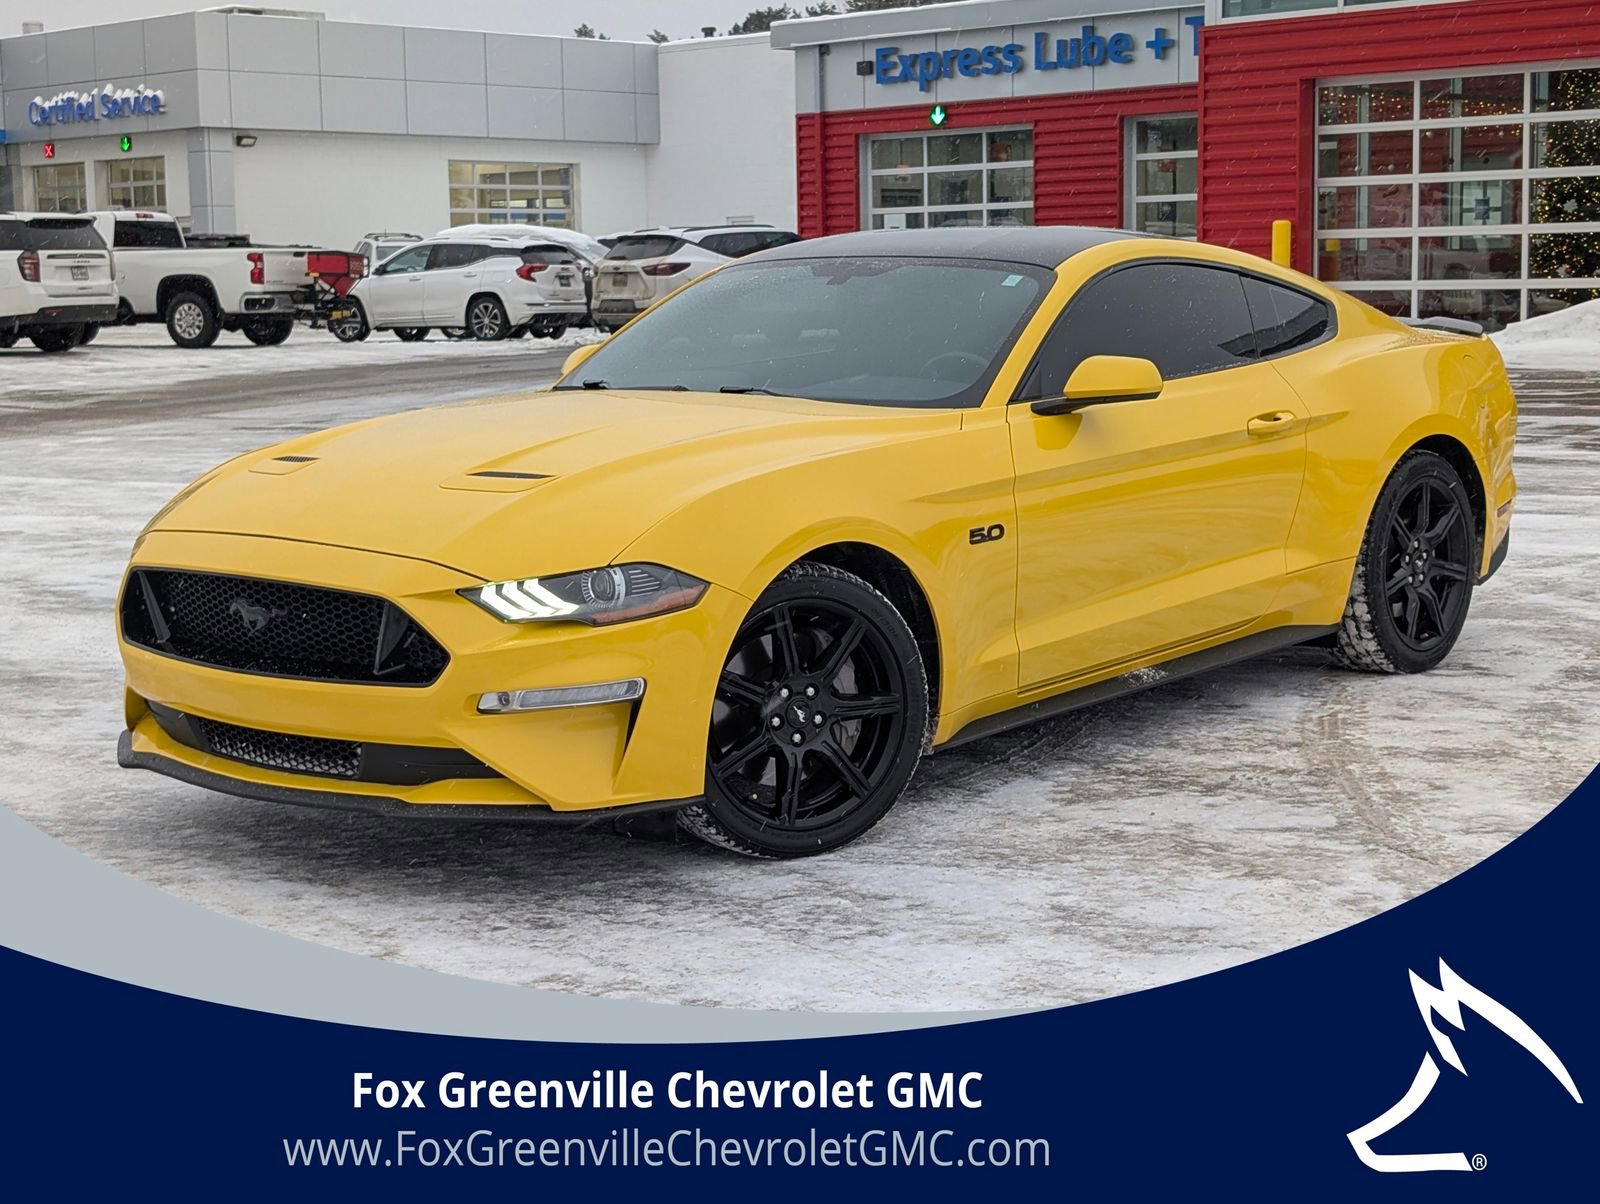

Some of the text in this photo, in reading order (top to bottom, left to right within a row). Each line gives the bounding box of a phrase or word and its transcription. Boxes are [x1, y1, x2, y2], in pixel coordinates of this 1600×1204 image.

[875, 42, 1025, 93] Express
[1034, 25, 1135, 71] Lube
[28, 90, 166, 126] Certified Service
